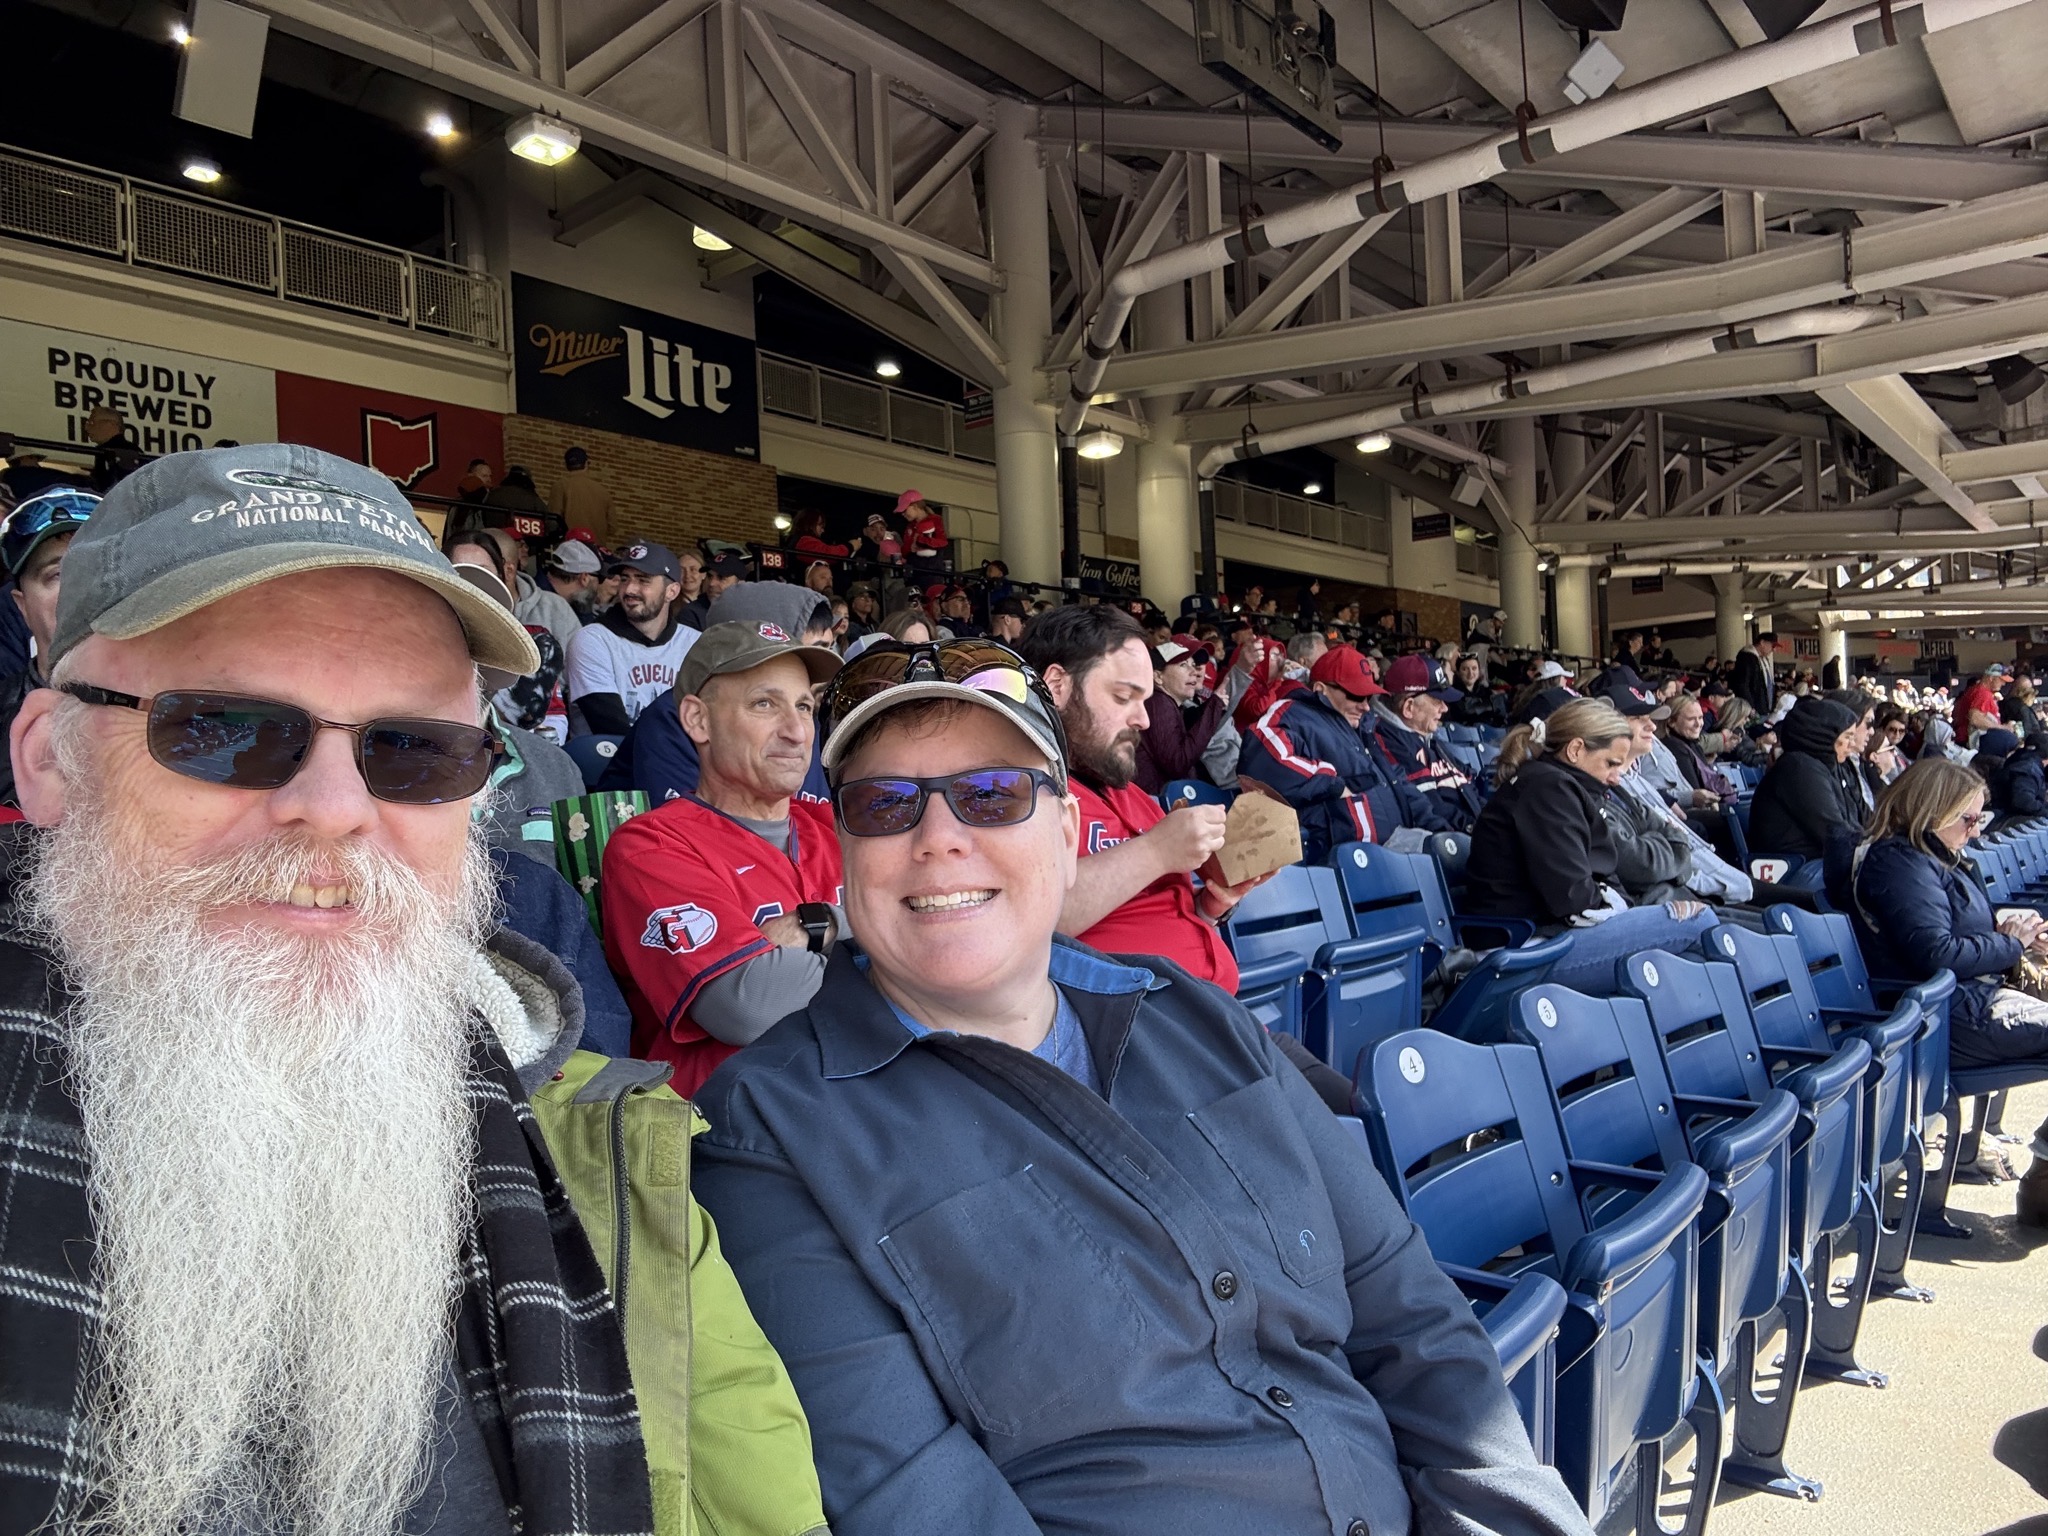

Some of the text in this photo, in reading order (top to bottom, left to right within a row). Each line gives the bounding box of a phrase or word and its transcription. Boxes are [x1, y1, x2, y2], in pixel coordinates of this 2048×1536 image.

[529, 323, 624, 366] Miller
[48, 347, 216, 400] PROUDLY
[619, 325, 732, 419] Lite
[54, 380, 212, 429] BREWED
[190, 491, 434, 553] GRAND TETON
[236, 506, 408, 546] NATIONAL PARK
[514, 518, 541, 535] 136
[762, 552, 782, 567] 138
[1105, 563, 1140, 587] Coffee
[1760, 864, 1773, 883] C
[1543, 1005, 1552, 1020] 5
[1409, 1056, 1418, 1074] 4
